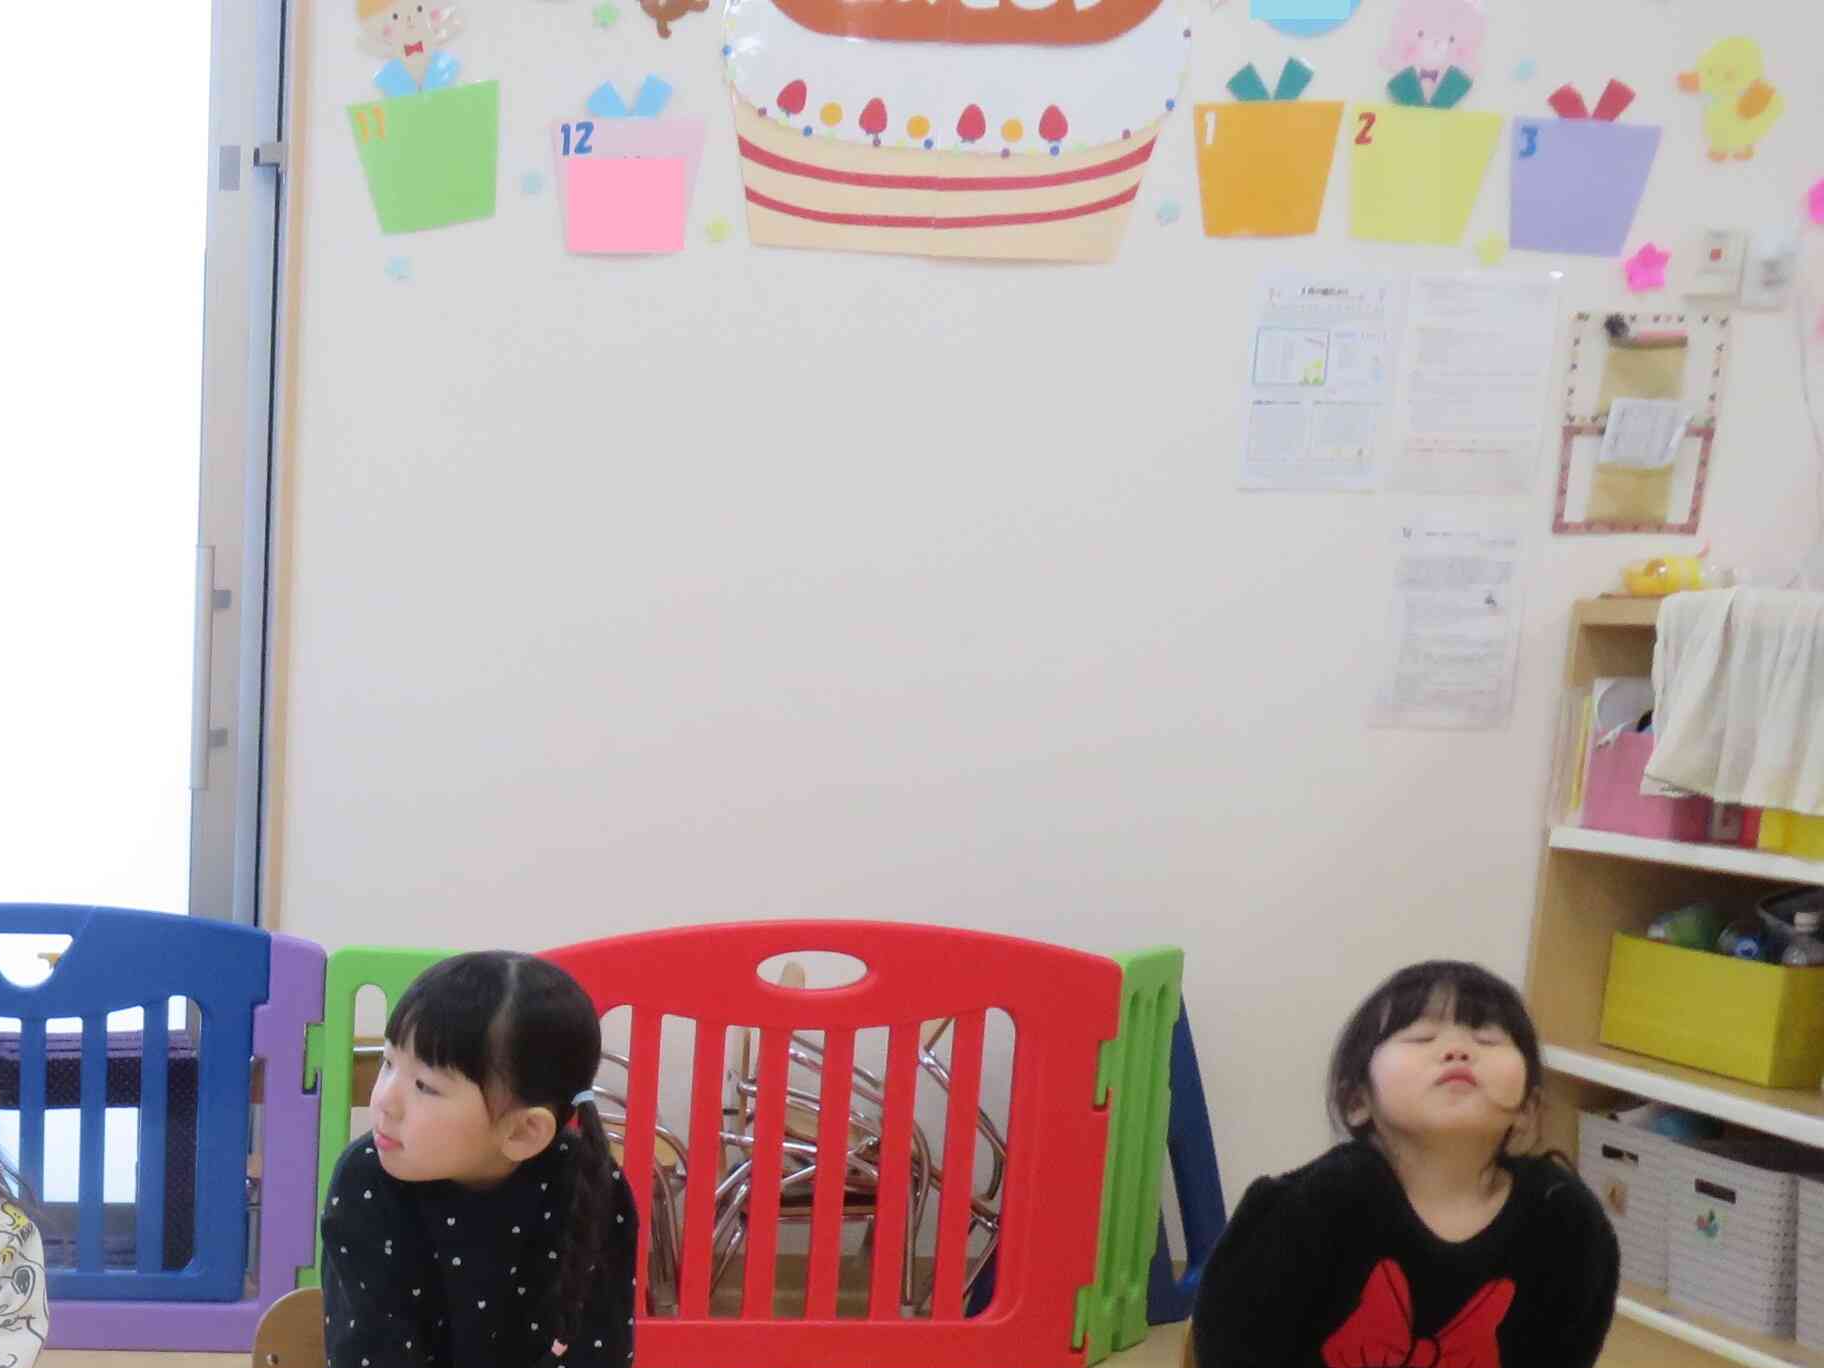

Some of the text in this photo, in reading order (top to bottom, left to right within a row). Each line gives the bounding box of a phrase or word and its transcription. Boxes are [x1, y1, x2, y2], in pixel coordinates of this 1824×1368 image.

[355, 106, 385, 143] 11
[561, 121, 593, 155] 12
[1204, 111, 1217, 145] 1
[1354, 111, 1376, 145] 2
[1519, 127, 1538, 158] 3
